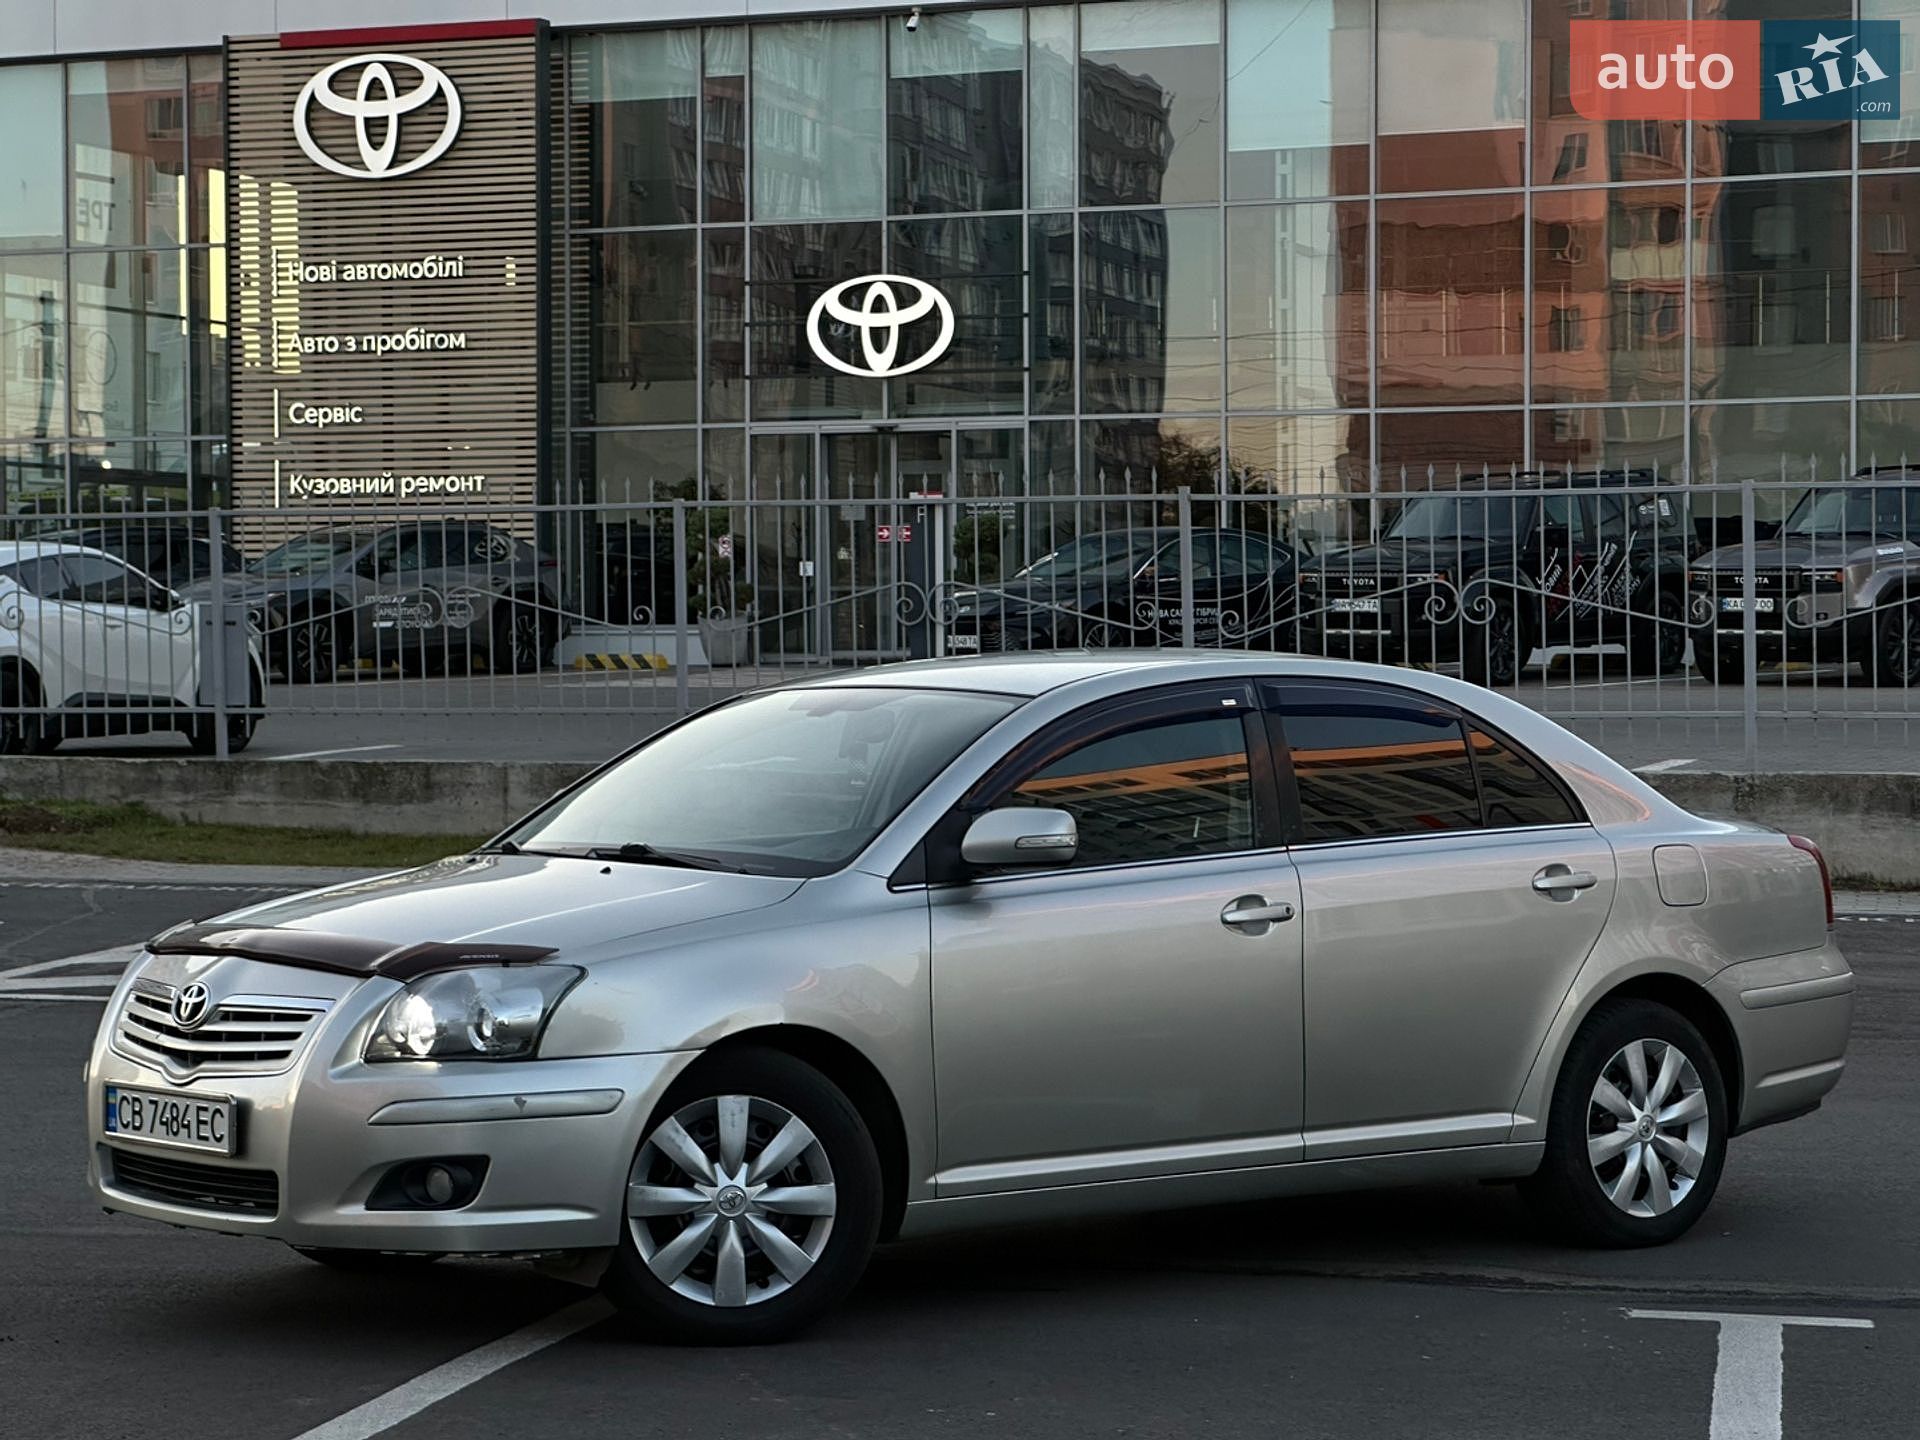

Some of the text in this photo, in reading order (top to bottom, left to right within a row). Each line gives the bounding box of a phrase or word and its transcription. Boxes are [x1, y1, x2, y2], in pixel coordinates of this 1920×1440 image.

[288, 255, 465, 282] Нові автомобілі
[288, 326, 467, 357] Авто з пробігом
[288, 401, 364, 429] Сервіс
[289, 471, 486, 500] Кузовний ремонт
[1734, 576, 1770, 584] TOTA
[118, 1094, 225, 1144] CB 7484 EC
